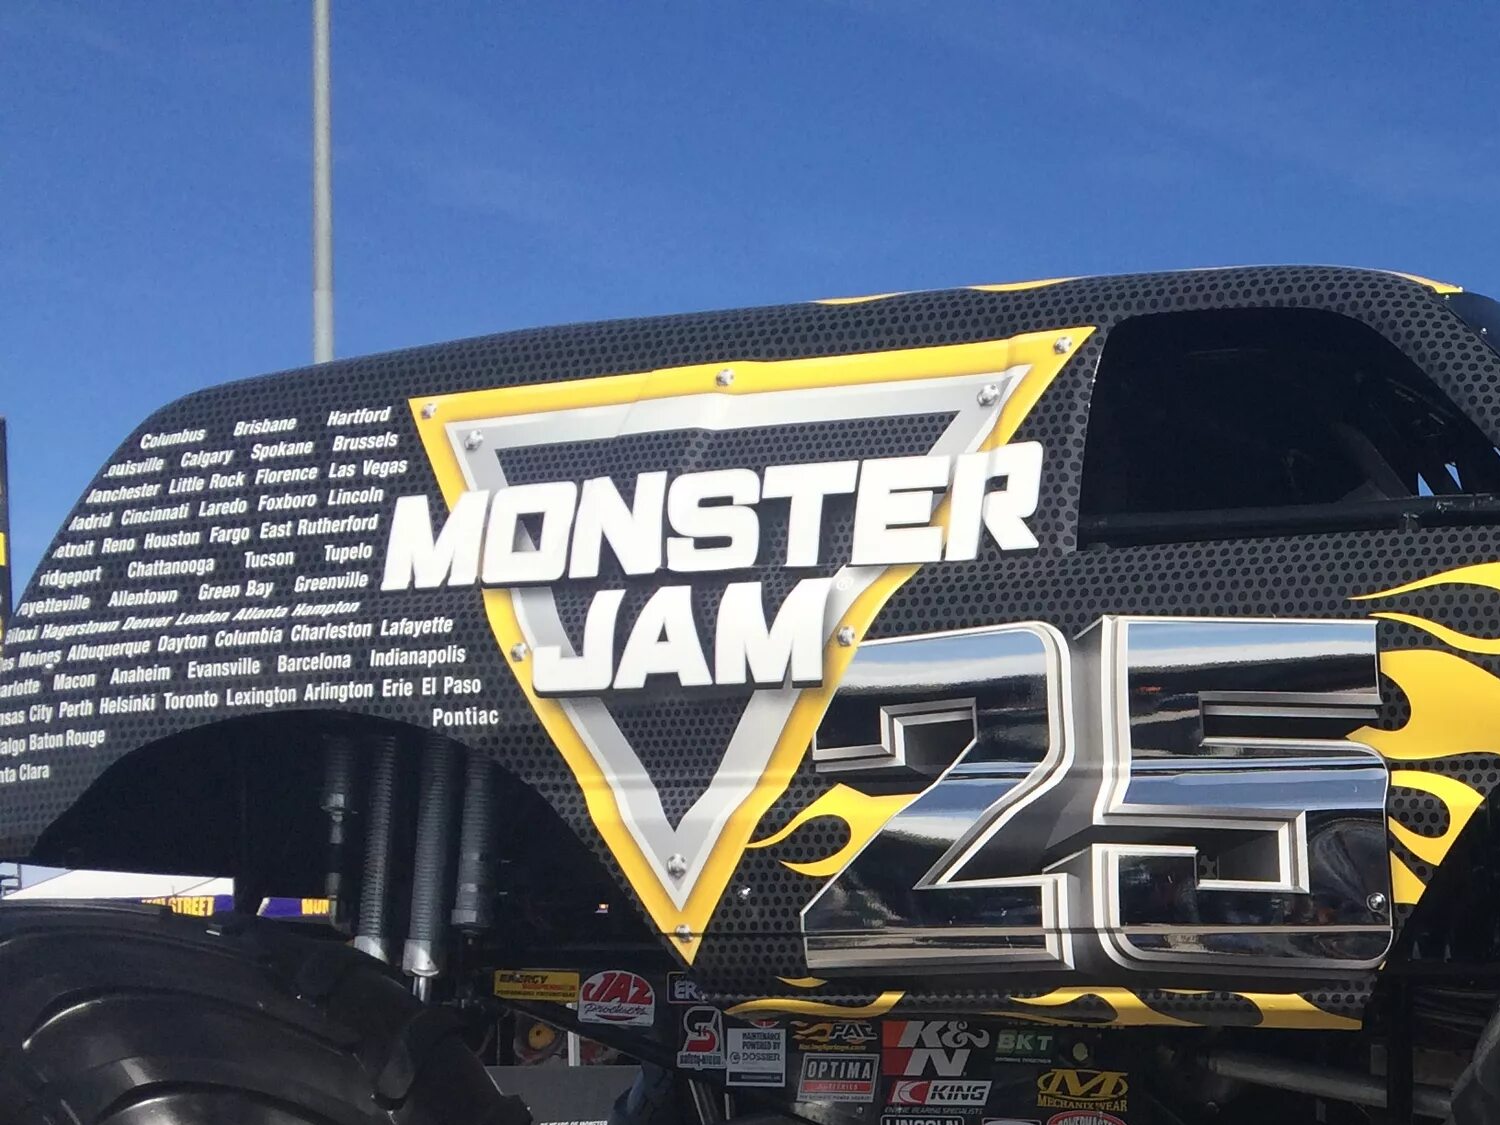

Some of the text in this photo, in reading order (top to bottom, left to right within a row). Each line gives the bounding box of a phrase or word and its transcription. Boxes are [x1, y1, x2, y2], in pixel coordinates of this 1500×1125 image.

[140, 406, 391, 449] Columbus Brisbane Hartford
[103, 432, 399, 478] ouisville Calgary Spokane Brussels
[168, 477, 205, 494] Little
[209, 472, 247, 489] Rock
[255, 466, 318, 485] Florence
[328, 462, 356, 478] Las
[362, 459, 408, 478] Vegas
[121, 502, 190, 526] Cincinnati
[199, 497, 248, 517] Laredo
[258, 493, 317, 511] Foxboro
[327, 486, 384, 506] Lincoln
[380, 440, 1043, 591] MONSTER
[52, 514, 380, 559] etroit Reno Houston Fargo East Rutherford
[39, 542, 373, 589] ridgeport Chattanooga Tucson Tupelo
[108, 589, 178, 607] Allentown
[198, 583, 241, 600] Green
[246, 580, 275, 598] Bay
[294, 571, 369, 593] Greenville
[41, 620, 120, 640] Hagerstown
[121, 616, 174, 631] Denver
[175, 610, 231, 627] London
[232, 605, 289, 621] Atlanta
[291, 601, 361, 617] Hampton
[532, 578, 836, 697] JAM
[18, 650, 61, 668] Moines
[67, 639, 151, 662] Albuquerque
[157, 633, 208, 653] Dayton
[215, 626, 283, 647] Columbia
[291, 622, 373, 641] Charleston
[380, 616, 453, 637] Lafayette
[0, 644, 466, 698] arlotte Macon Anaheim Evansville Barcelona Indianapolis
[29, 704, 53, 723] City
[59, 699, 94, 719] Perth
[99, 694, 156, 714] Helsinki
[163, 690, 218, 710] Toronto
[226, 687, 297, 707] Lexington
[303, 681, 373, 703] Arlington
[382, 678, 413, 697] Erie
[422, 677, 436, 695] El
[444, 676, 482, 695] Paso
[432, 706, 499, 727] Pontiac
[29, 732, 63, 750] Baton
[66, 729, 105, 748] Rouge
[19, 763, 50, 781] Clara
[799, 614, 1394, 971] 25
[583, 972, 652, 1005] JAZ
[584, 1003, 650, 1016] Products
[999, 1031, 1053, 1051] BKT
[807, 1061, 871, 1079] OPTIMA
[931, 1086, 986, 1100] KING
[1037, 1094, 1127, 1112] MECHANIX WEAR
